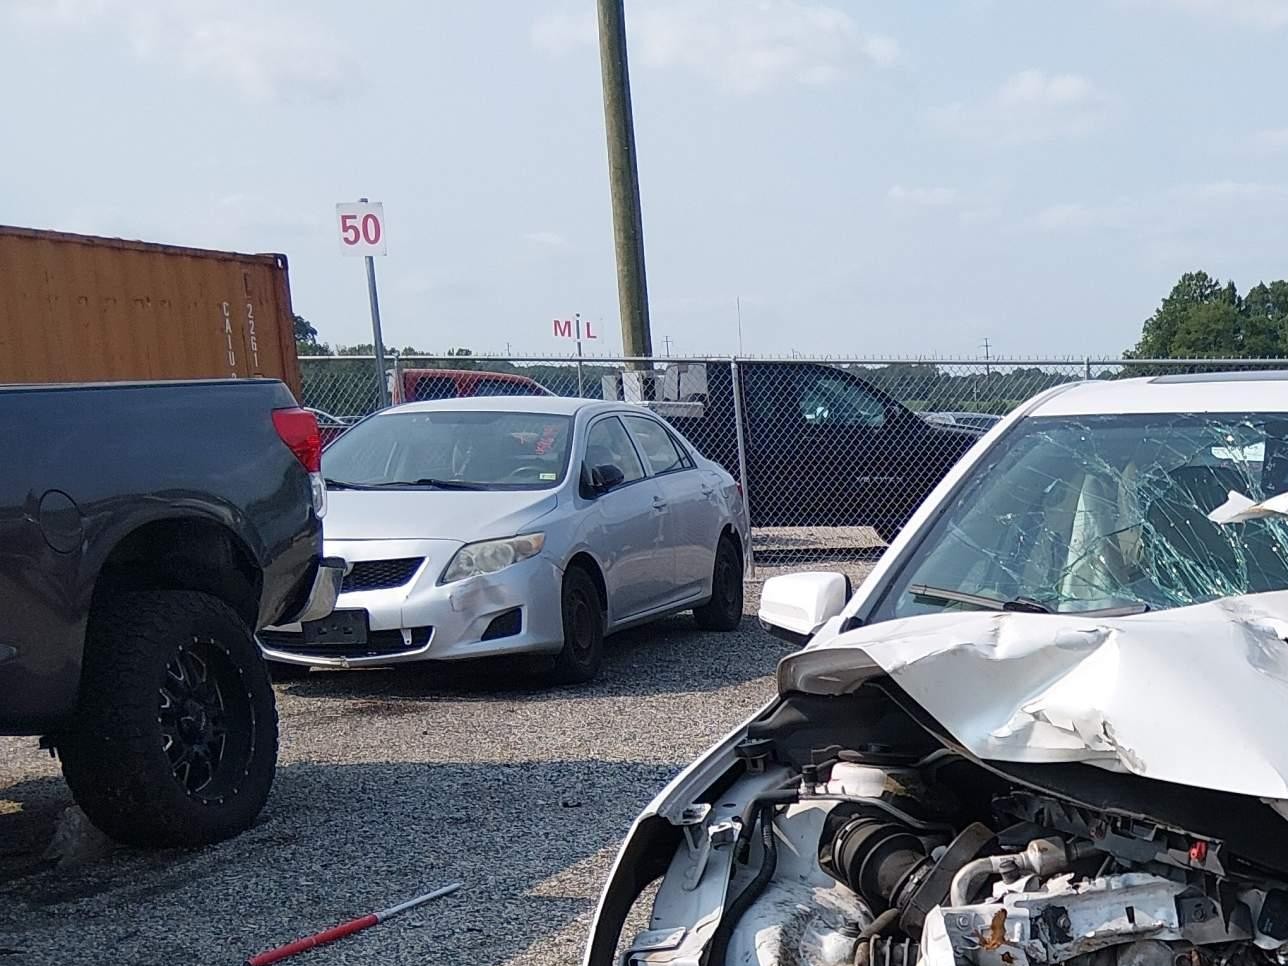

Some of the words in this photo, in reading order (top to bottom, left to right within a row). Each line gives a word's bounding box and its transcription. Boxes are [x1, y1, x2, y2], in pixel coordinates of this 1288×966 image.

[341, 214, 381, 246] 50
[553, 319, 572, 338] M
[586, 321, 598, 339] L
